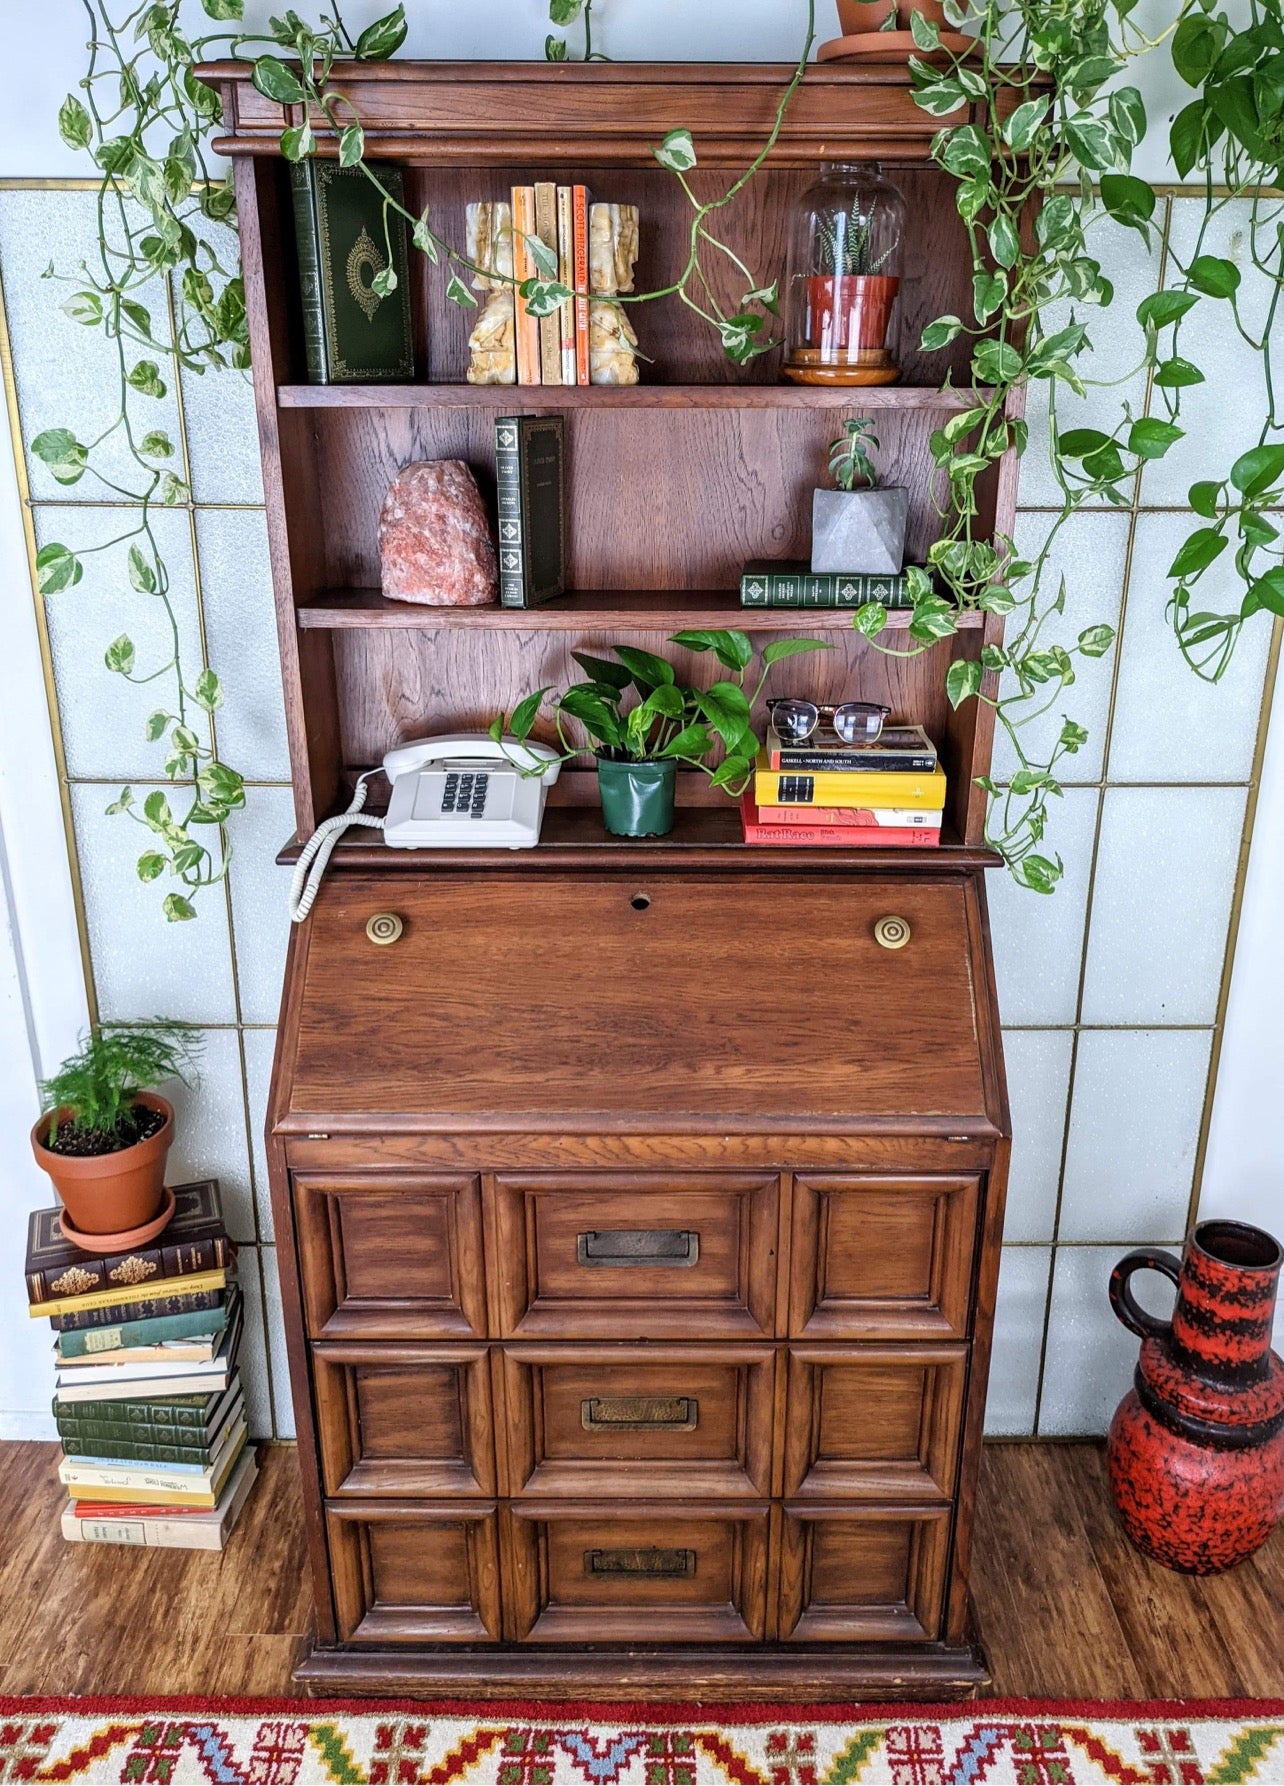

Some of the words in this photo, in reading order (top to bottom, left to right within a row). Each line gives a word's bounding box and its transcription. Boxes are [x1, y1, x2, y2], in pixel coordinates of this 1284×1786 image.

[577, 203, 585, 231] SCOTT
[577, 233, 586, 282] FITZGERALD
[756, 828, 781, 840] Rat
[782, 828, 815, 841] Race
